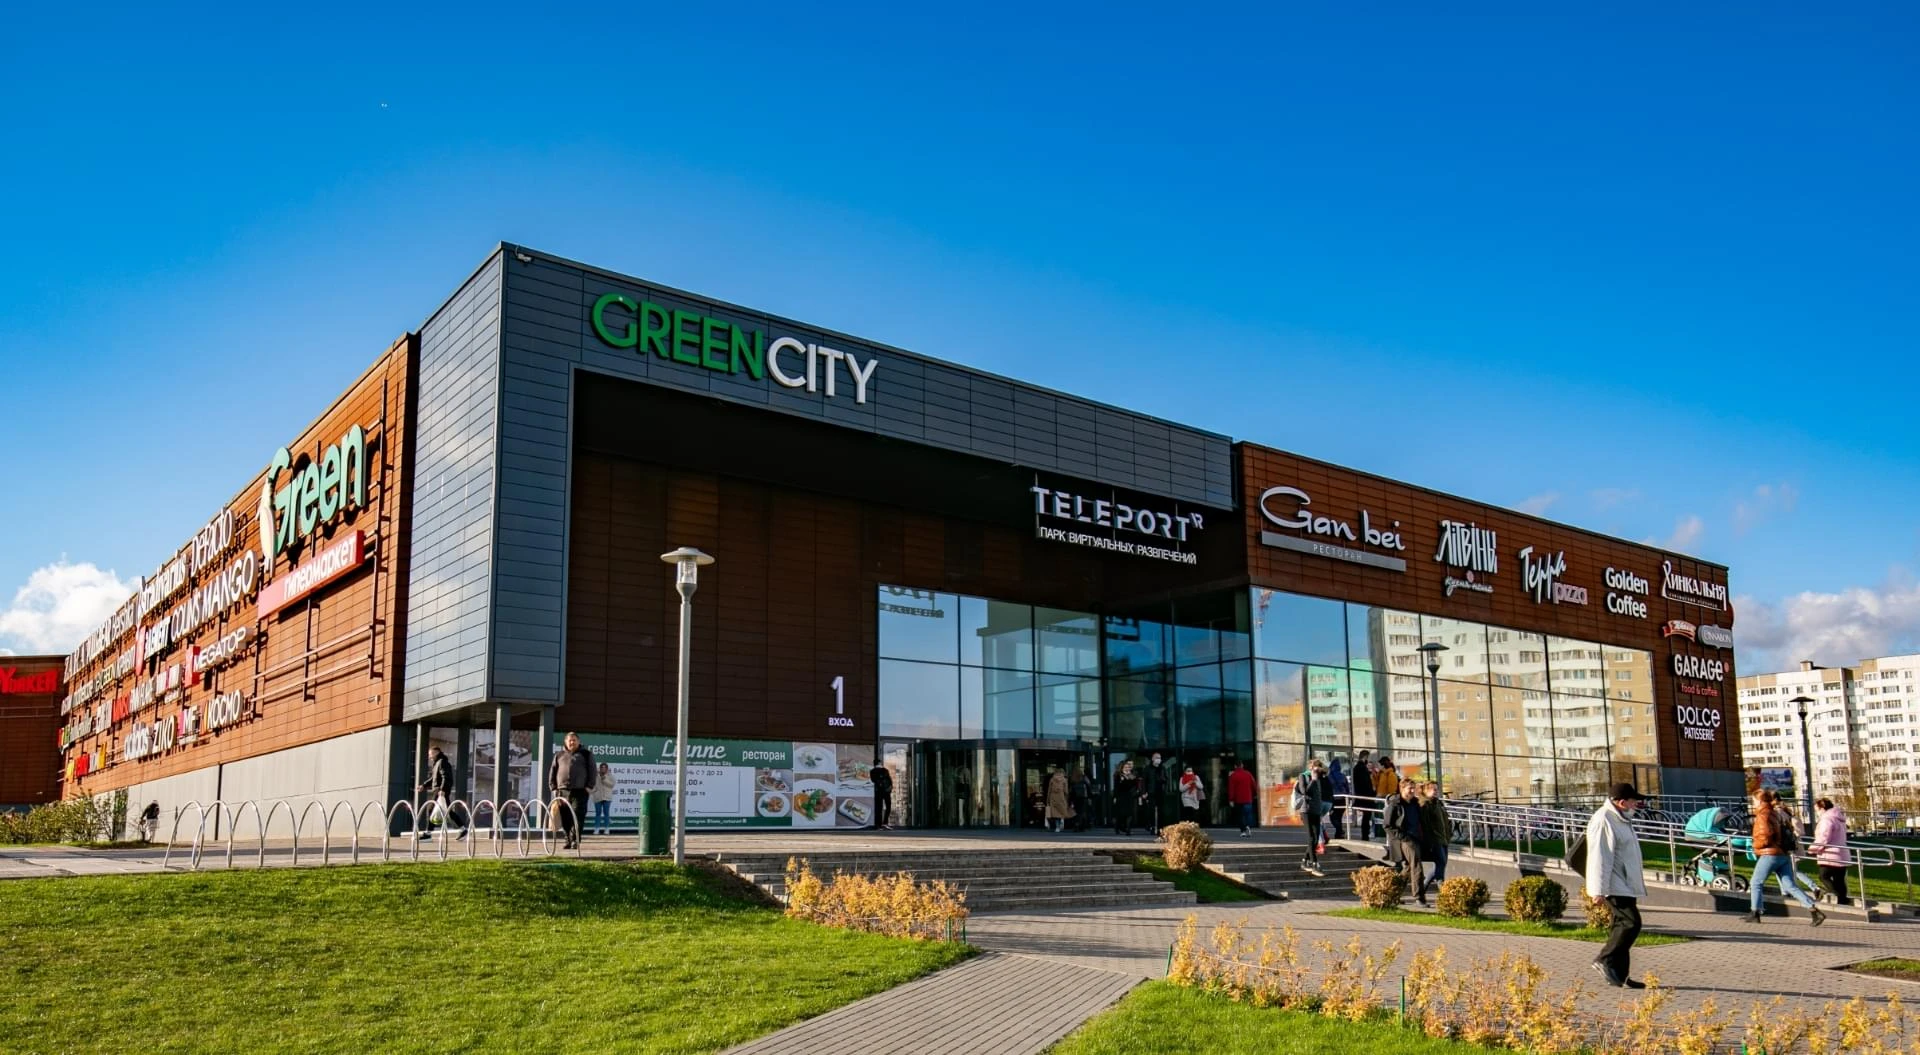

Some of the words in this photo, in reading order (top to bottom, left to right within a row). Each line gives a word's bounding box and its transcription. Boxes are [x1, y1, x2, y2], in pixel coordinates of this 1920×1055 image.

[1030, 486, 1190, 541] TELEPORT
[1260, 486, 1357, 541] Gan
[1362, 509, 1406, 551] bei
[1040, 526, 1066, 542] ПАРК
[1068, 531, 1135, 554] ВИРТУАЛЬНЫХ
[1137, 544, 1198, 566] РАЗВЛЕЧЕНИЙ
[1313, 543, 1363, 561] РЕСТОРАН
[201, 549, 255, 621] MANGO
[1553, 582, 1588, 606] pizza
[1605, 566, 1649, 595] Golden
[1607, 592, 1647, 619] Coffee
[194, 627, 247, 672] MEGATOP
[830, 676, 844, 714] 1
[1681, 683, 1696, 694] food
[1701, 686, 1719, 697] coffee
[152, 714, 176, 754] ZIKO
[828, 717, 855, 727] ВХОД
[1684, 726, 1715, 741] PATISSERIE
[587, 744, 644, 756] restaurant
[742, 750, 786, 762] ресторан
